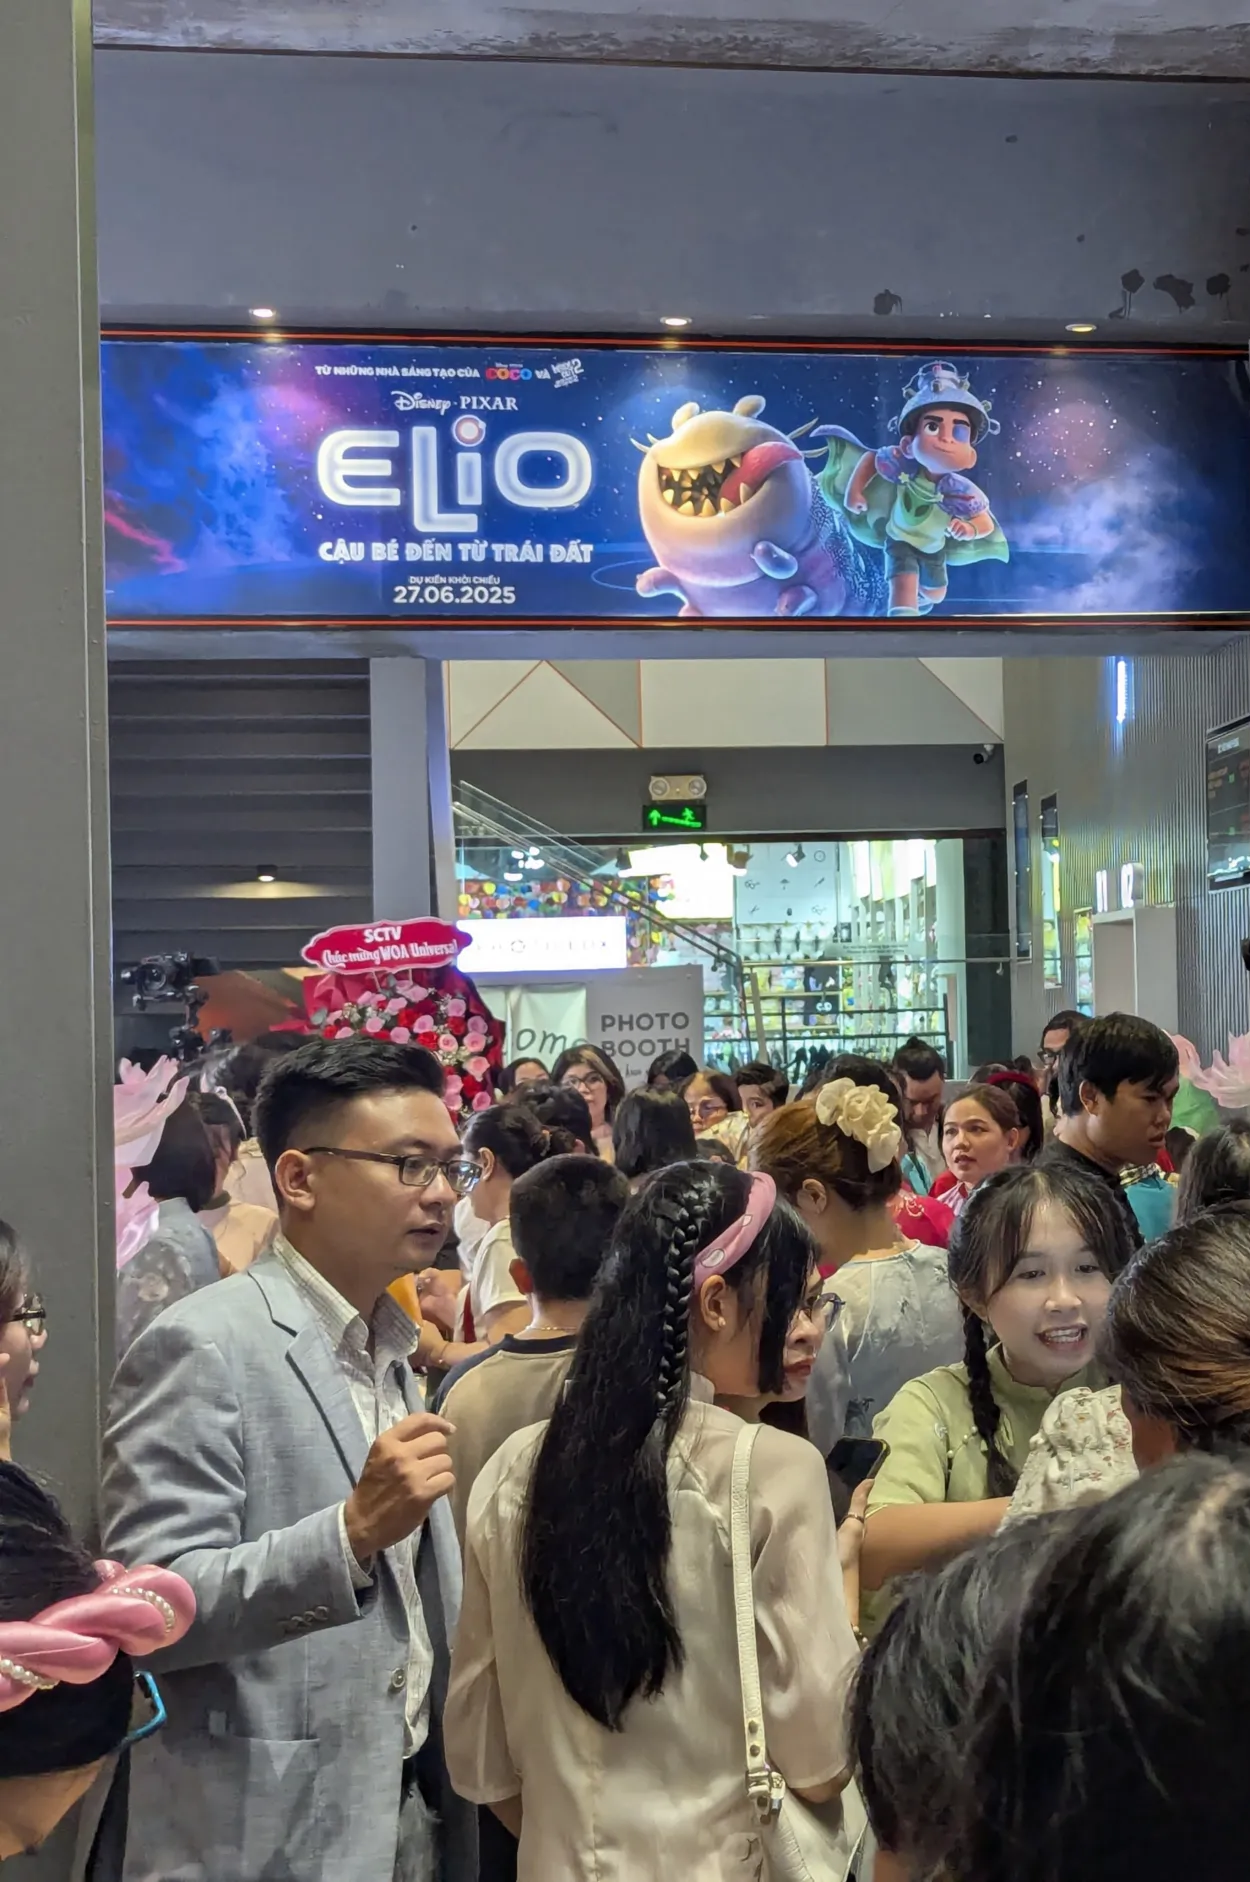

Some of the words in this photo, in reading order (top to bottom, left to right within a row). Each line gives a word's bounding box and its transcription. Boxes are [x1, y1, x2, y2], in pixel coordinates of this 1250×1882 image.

[460, 396, 519, 411] PIXAR
[319, 539, 364, 564] CẬU
[372, 539, 399, 561] BÉ
[406, 538, 452, 561] ĐẾN
[458, 539, 488, 562] TỪ
[492, 540, 543, 562] TRÁI
[550, 539, 593, 562] ĐẤT
[393, 586, 516, 604] 27.06.2025
[364, 926, 402, 943] SCTV
[322, 949, 348, 968] Chúc
[380, 944, 409, 961] WOA
[409, 939, 457, 958] Universal
[601, 1012, 690, 1032] PHOTO
[601, 1038, 690, 1057] BOOTH
